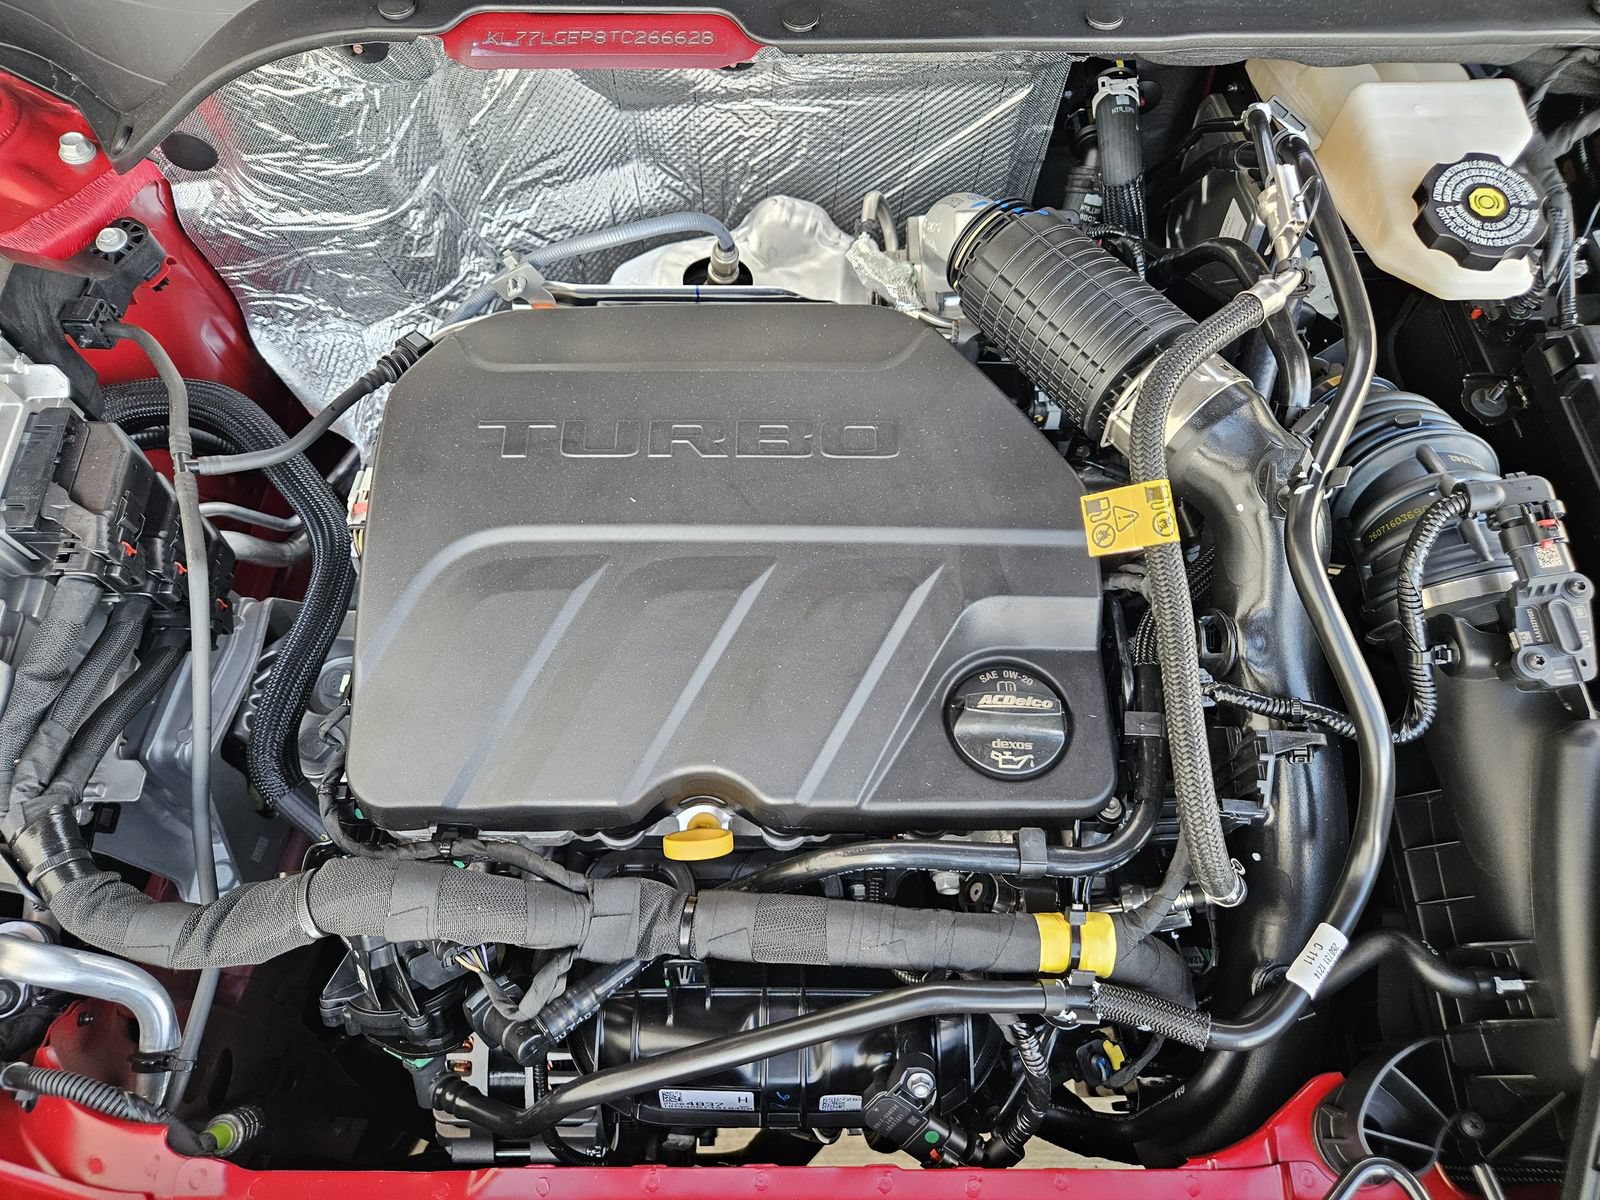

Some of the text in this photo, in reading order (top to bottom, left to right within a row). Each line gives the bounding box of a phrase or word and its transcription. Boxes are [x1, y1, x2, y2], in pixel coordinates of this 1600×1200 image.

[478, 420, 899, 459] TURBO
[979, 670, 1034, 686] SAE 0W-20
[977, 694, 1054, 708] ACDelco
[991, 739, 1034, 750] dexos
[1303, 942, 1324, 965] C 111
[738, 1096, 748, 1104] H
